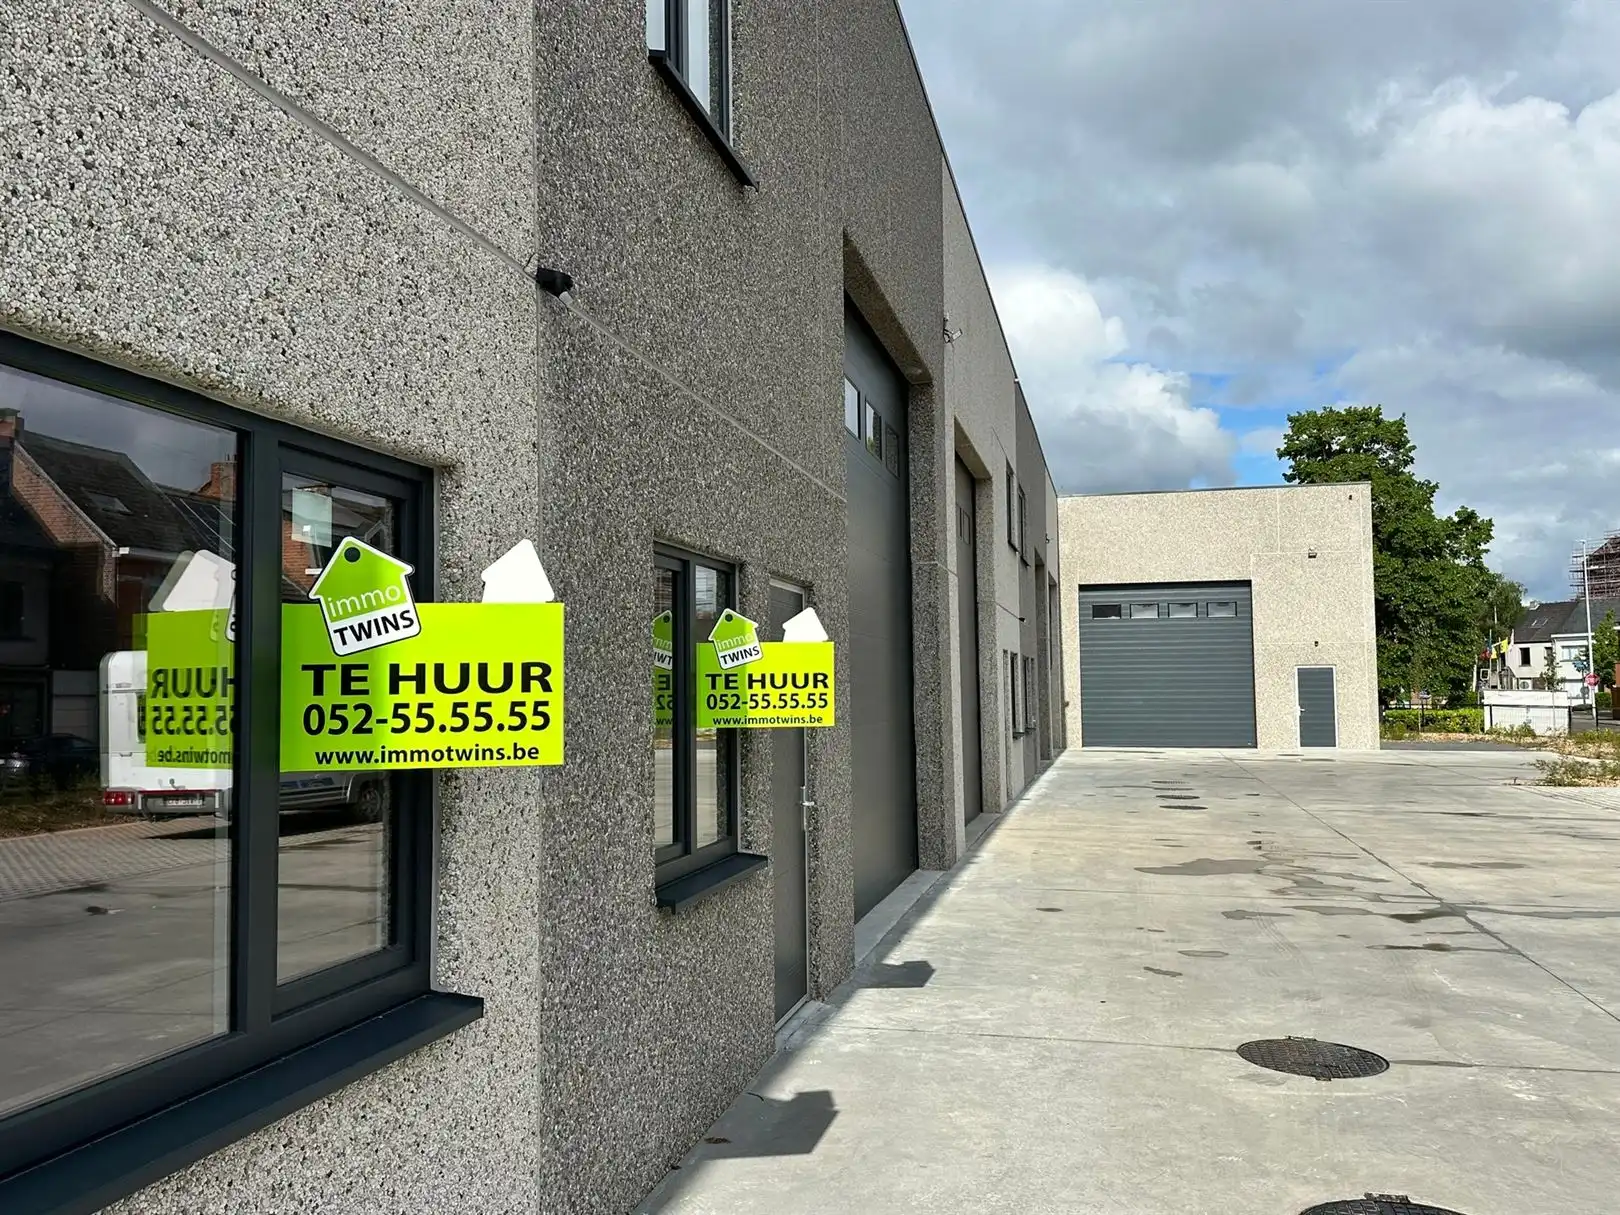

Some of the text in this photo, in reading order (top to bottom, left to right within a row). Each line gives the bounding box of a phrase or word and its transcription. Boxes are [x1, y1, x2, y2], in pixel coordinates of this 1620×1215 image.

[327, 585, 401, 617] immo
[333, 609, 415, 646] TWINS
[716, 633, 754, 650] immo
[720, 645, 760, 665] TWINS
[301, 661, 553, 696] TE HUUR
[705, 672, 829, 690] TE HUUR
[706, 692, 828, 710] 052-55.55.55
[303, 700, 551, 735] 052-55.55.55
[712, 714, 823, 726] www.immotwins.be
[315, 742, 540, 765] www.immotwins.be
